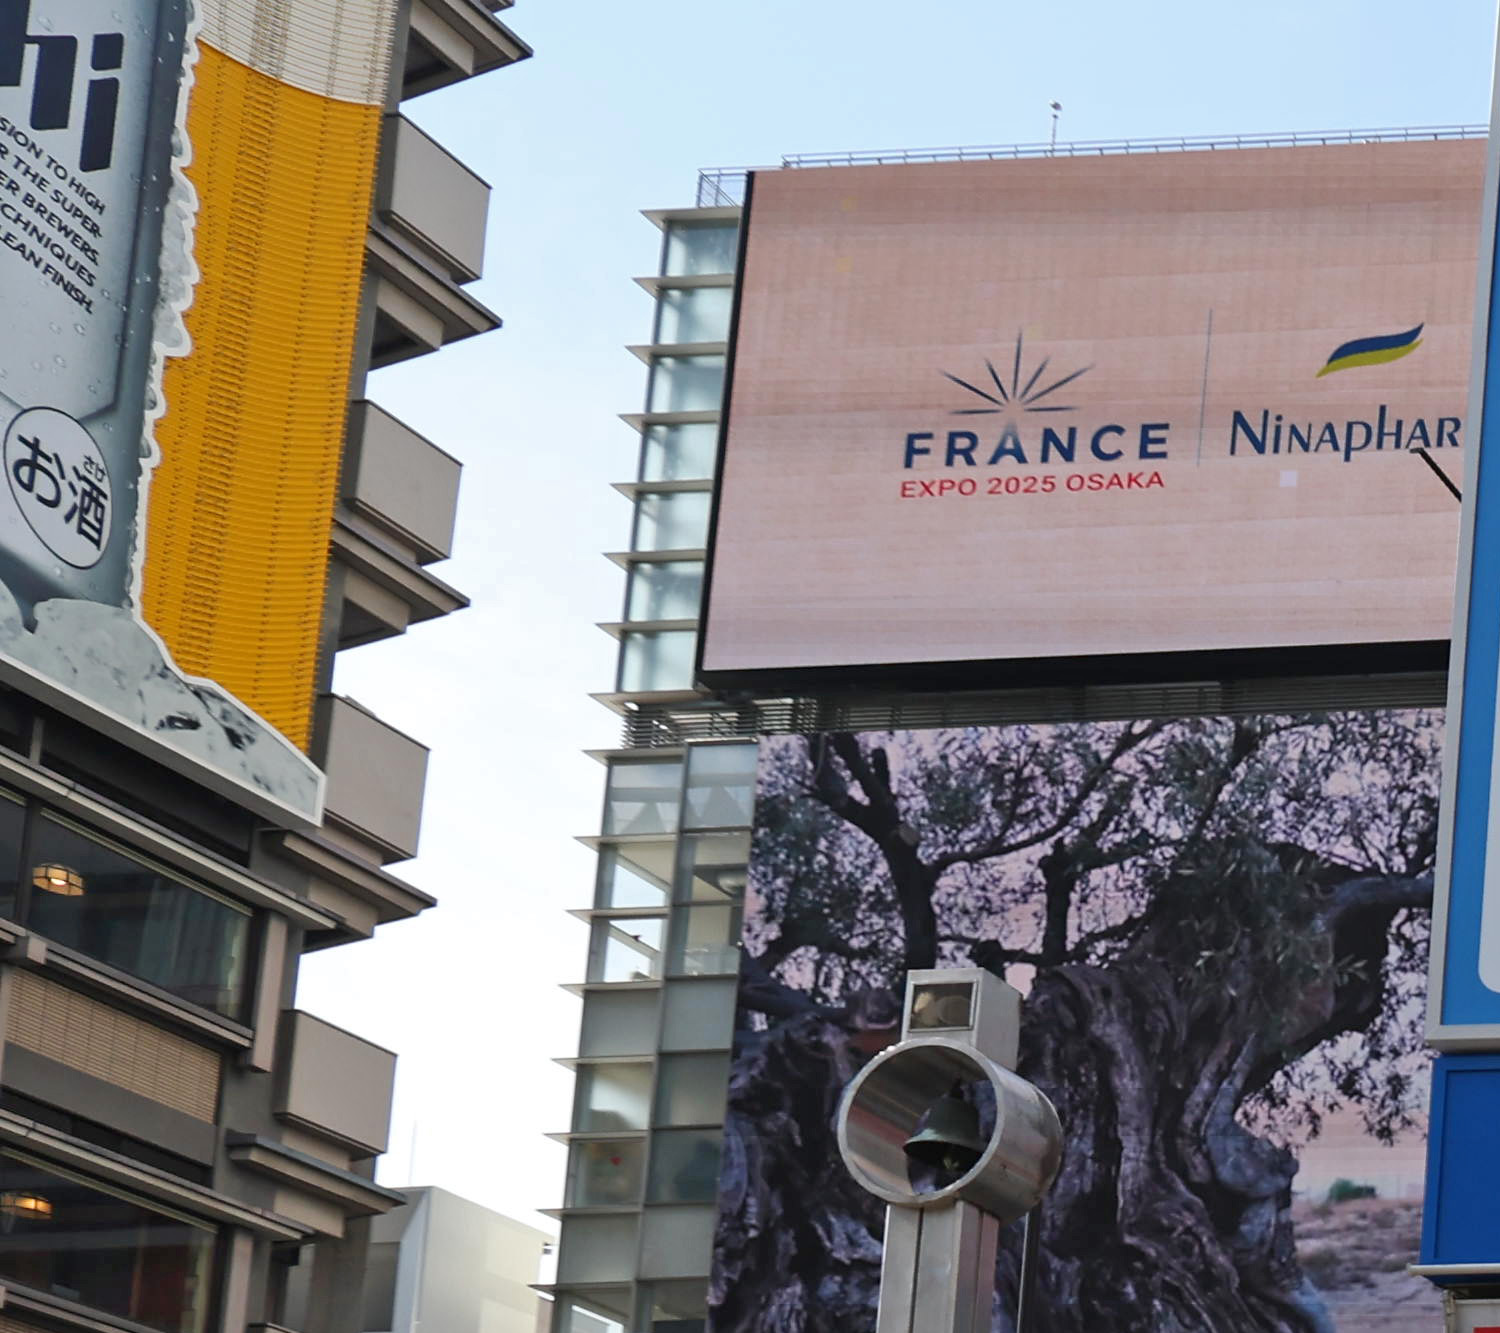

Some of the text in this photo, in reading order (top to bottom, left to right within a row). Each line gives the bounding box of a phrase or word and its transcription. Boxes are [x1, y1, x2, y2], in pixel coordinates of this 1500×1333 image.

[12, 155, 50, 193] THE
[68, 176, 105, 216] HIGH
[22, 194, 99, 266] BREWERS.
[43, 264, 93, 314] FINISH.
[903, 423, 1170, 469] FRANCE
[13, 433, 111, 553] お酒
[900, 472, 1165, 498] EXPO 2025 OSAKA
